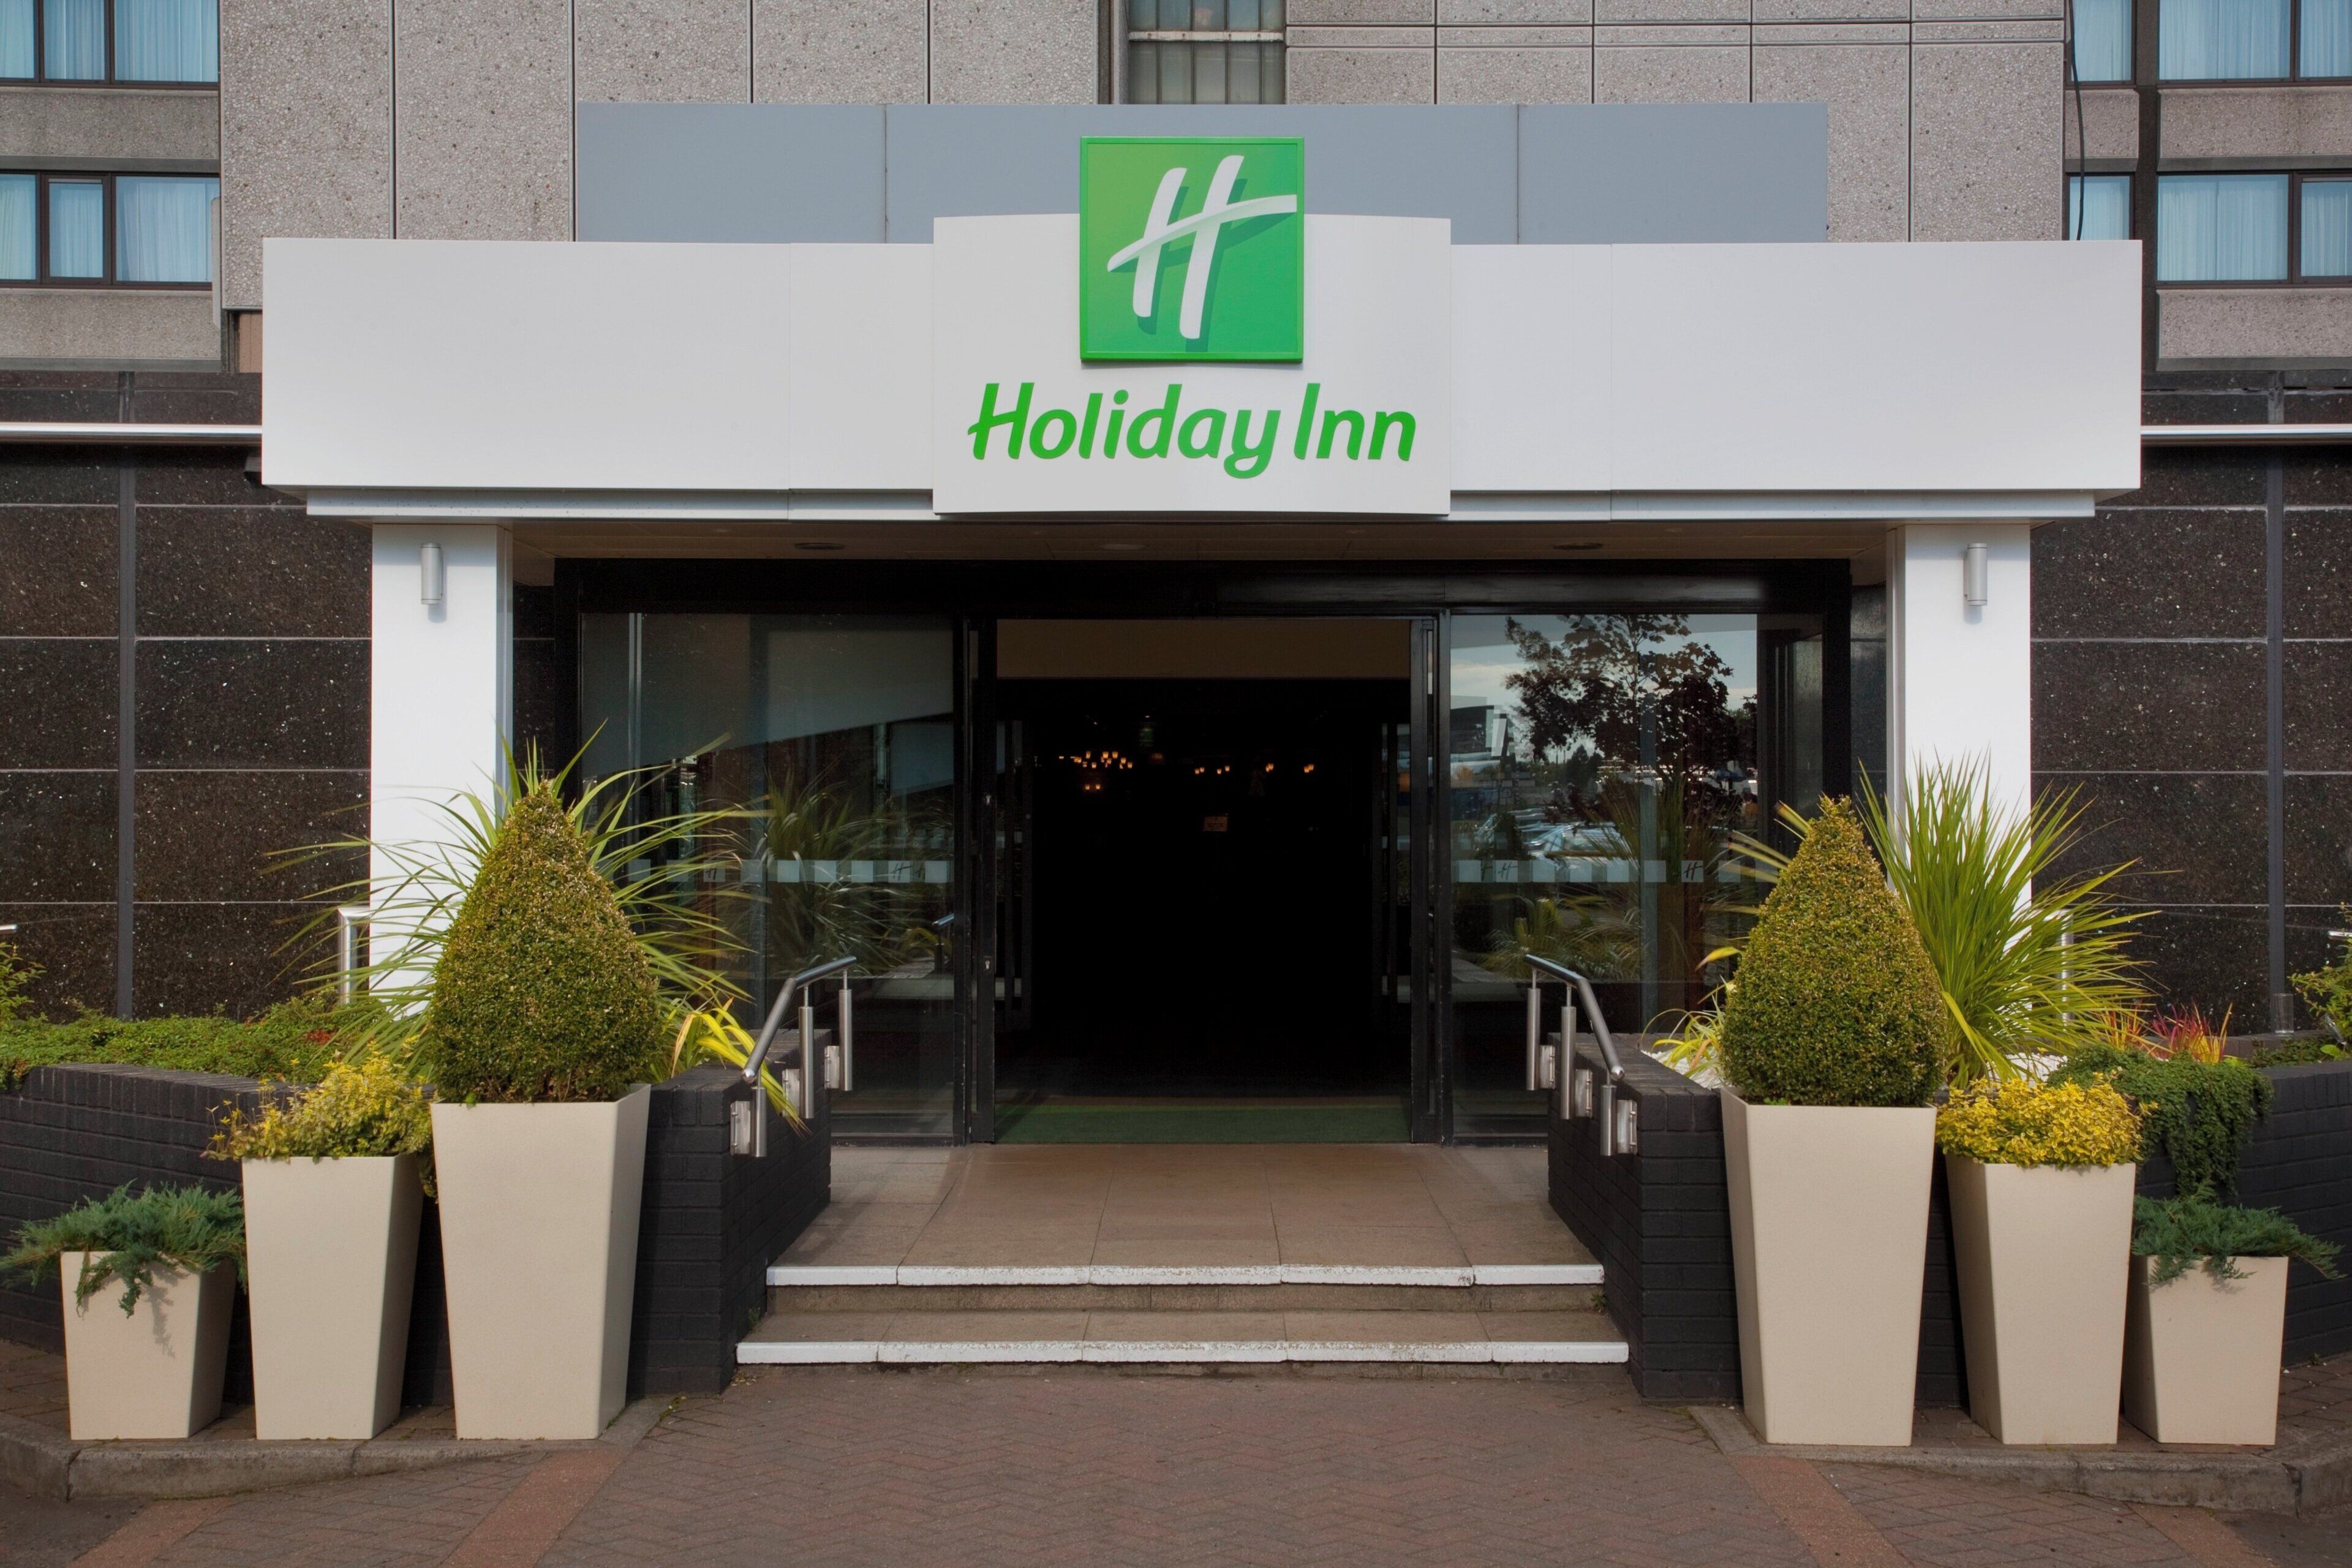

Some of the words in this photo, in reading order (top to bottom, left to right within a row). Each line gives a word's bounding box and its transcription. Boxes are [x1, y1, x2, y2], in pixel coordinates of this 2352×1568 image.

[1107, 155, 1297, 339] H
[967, 382, 1280, 479] Holiday
[1294, 382, 1416, 461] Inn
